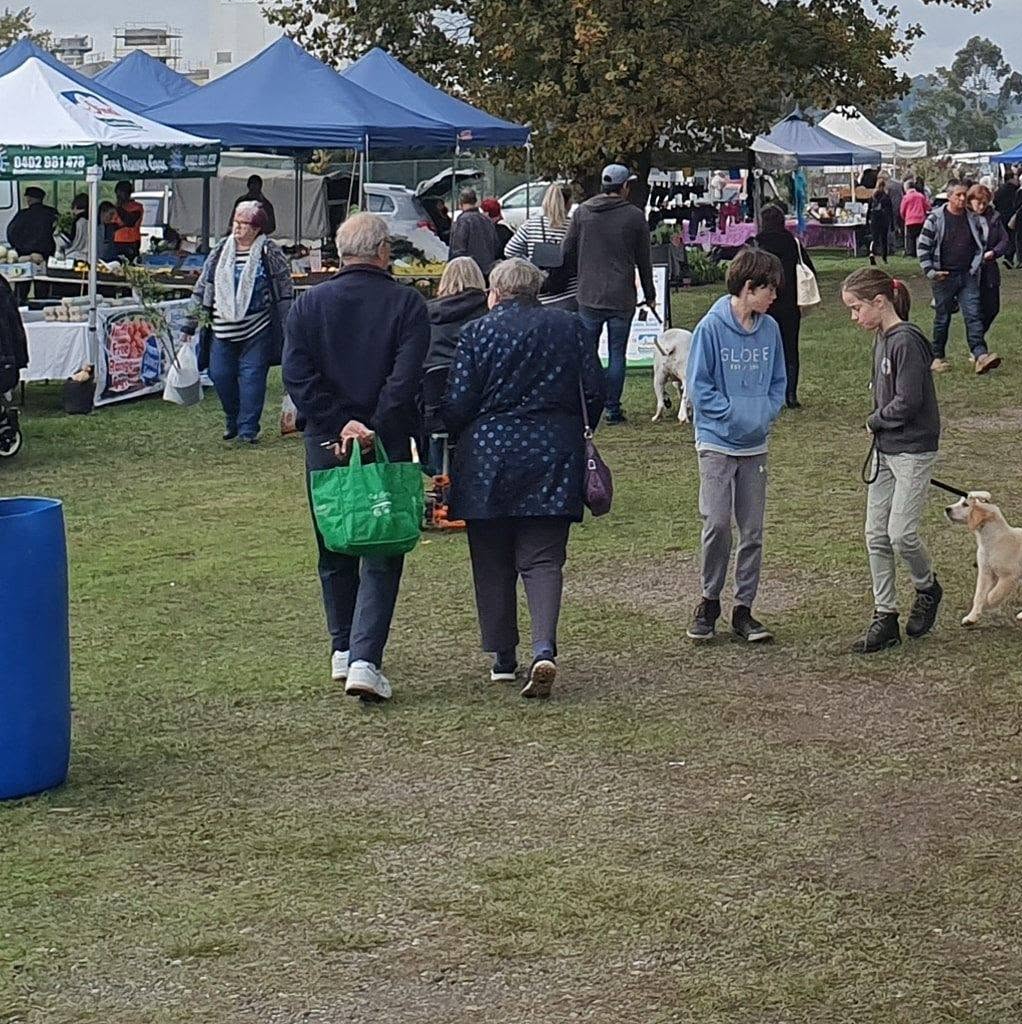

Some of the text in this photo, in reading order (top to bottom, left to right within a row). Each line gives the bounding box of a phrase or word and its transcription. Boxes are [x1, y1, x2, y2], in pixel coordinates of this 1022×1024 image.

[13, 156, 42, 169] 0402
[102, 154, 121, 172] Free
[122, 154, 149, 174] Range
[111, 341, 131, 357] Free
